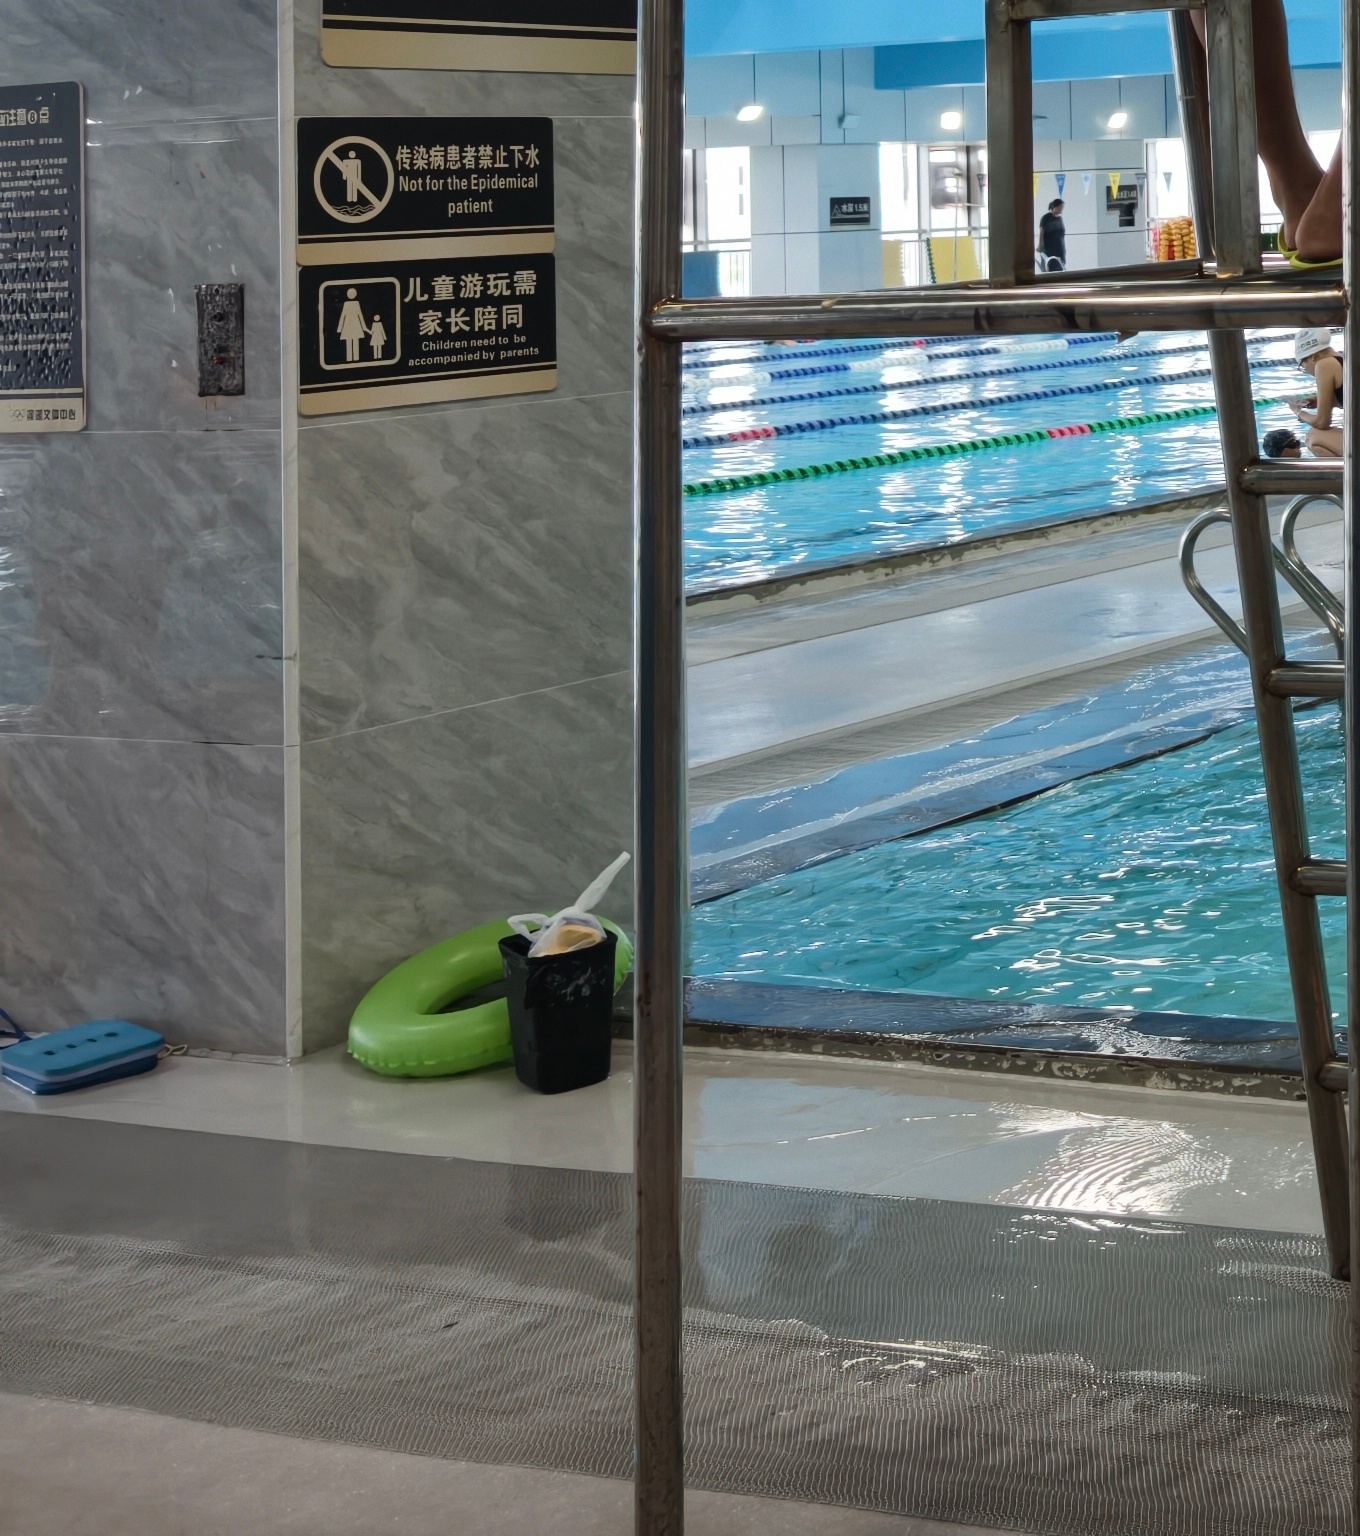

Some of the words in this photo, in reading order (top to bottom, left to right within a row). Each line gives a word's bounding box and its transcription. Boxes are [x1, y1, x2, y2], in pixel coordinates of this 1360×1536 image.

[395, 144, 540, 171] 传染病患者禁止下水
[399, 175, 423, 192] Not
[426, 175, 445, 191] for
[447, 174, 468, 190] the
[471, 173, 538, 193] Epidemical
[448, 198, 493, 217] patient
[403, 270, 537, 303] 儿童游玩需
[418, 304, 523, 336] 家长陪同
[422, 339, 468, 351] Children
[470, 336, 496, 347] need
[498, 335, 509, 345] to
[513, 334, 527, 343] be
[408, 351, 480, 367] accompanied
[482, 348, 496, 361] by
[500, 346, 539, 360] parents
